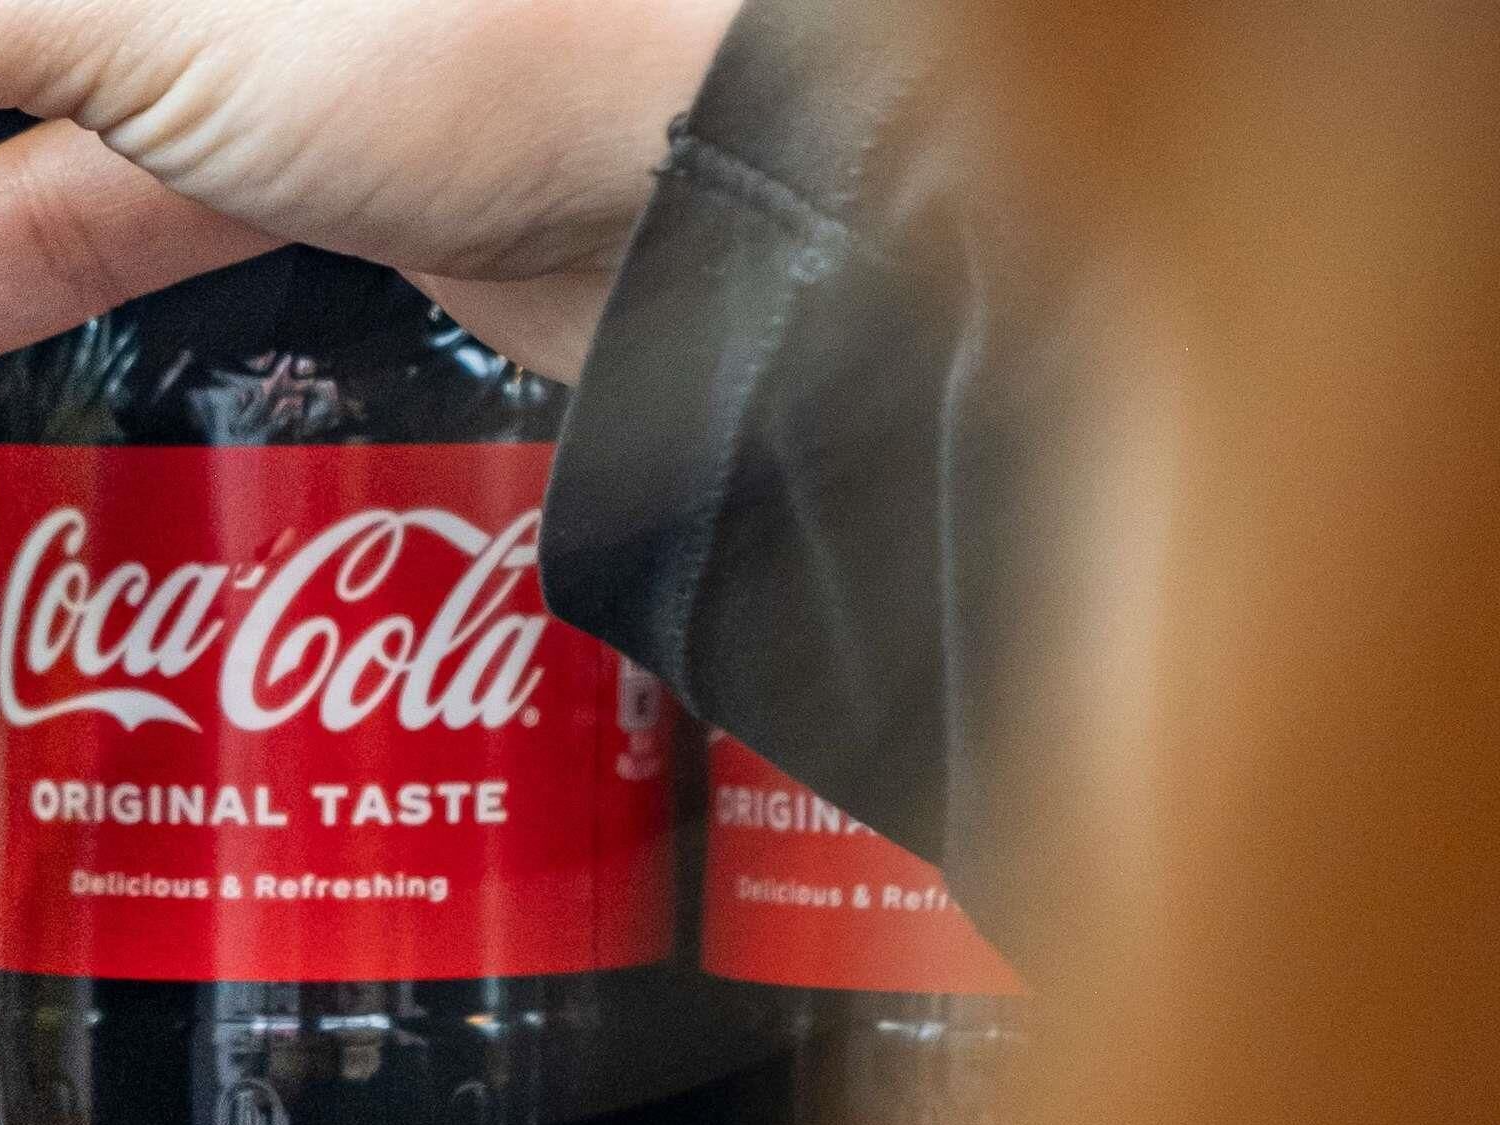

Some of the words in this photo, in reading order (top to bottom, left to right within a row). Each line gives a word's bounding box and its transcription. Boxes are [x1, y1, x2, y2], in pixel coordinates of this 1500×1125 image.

[32, 781, 288, 826] ORIGINAL
[312, 783, 508, 826] TASTE
[717, 786, 881, 837] ORIGIN
[71, 870, 209, 899] Delicious
[222, 873, 241, 899] &
[255, 872, 449, 902] Refreshing
